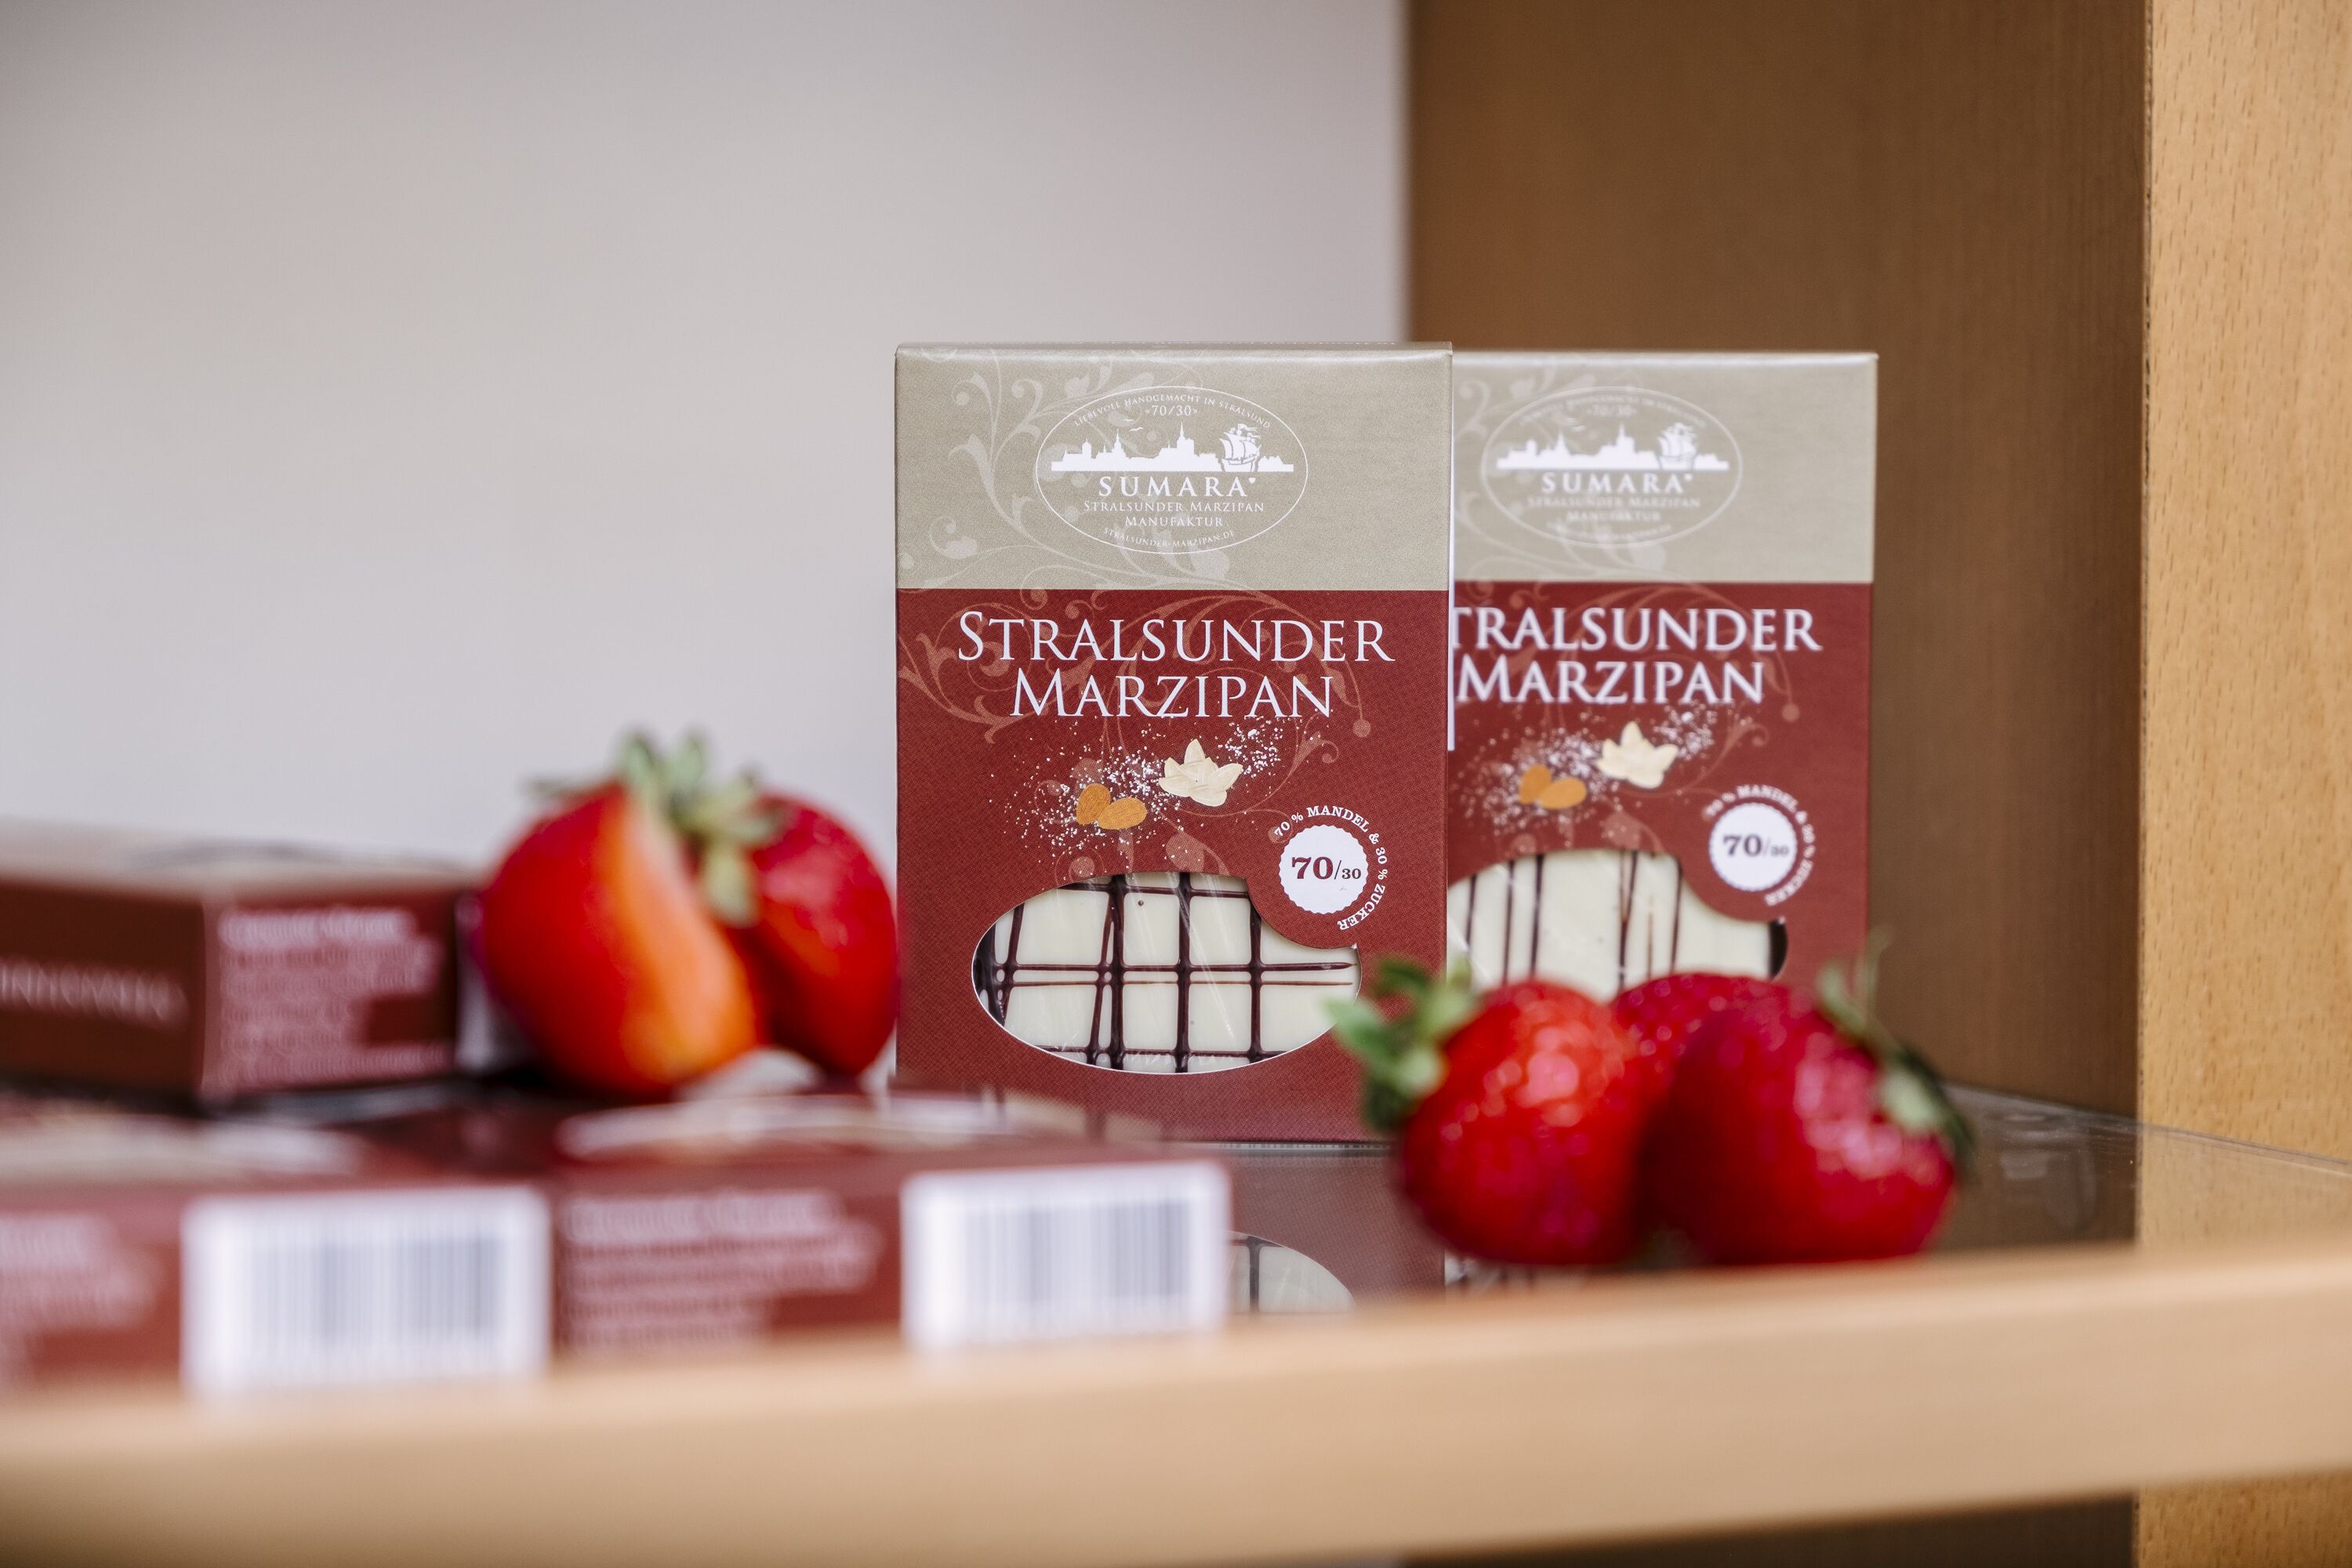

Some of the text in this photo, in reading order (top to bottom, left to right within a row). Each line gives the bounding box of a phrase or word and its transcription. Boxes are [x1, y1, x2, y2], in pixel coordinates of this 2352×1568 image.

[1124, 394, 1200, 407] HANDGEMACHT
[1218, 401, 1271, 429] STRALSUND
[1098, 476, 1247, 497] SUMARA
[1541, 471, 1684, 494] SUMARA
[1083, 500, 1265, 512] STRALSUNDER MARZIPAN
[1125, 516, 1224, 528] MANUFAKTUR
[957, 611, 1396, 662] STRALSUNDER
[1454, 607, 1824, 652] TRALSUNDER
[1009, 667, 1334, 718] MARZIPAN
[1455, 654, 1764, 704] MARZIPAN
[1274, 805, 1388, 931] 70 % MANDEL & 30 % ZUCKER
[1291, 856, 1362, 880] 70/30
